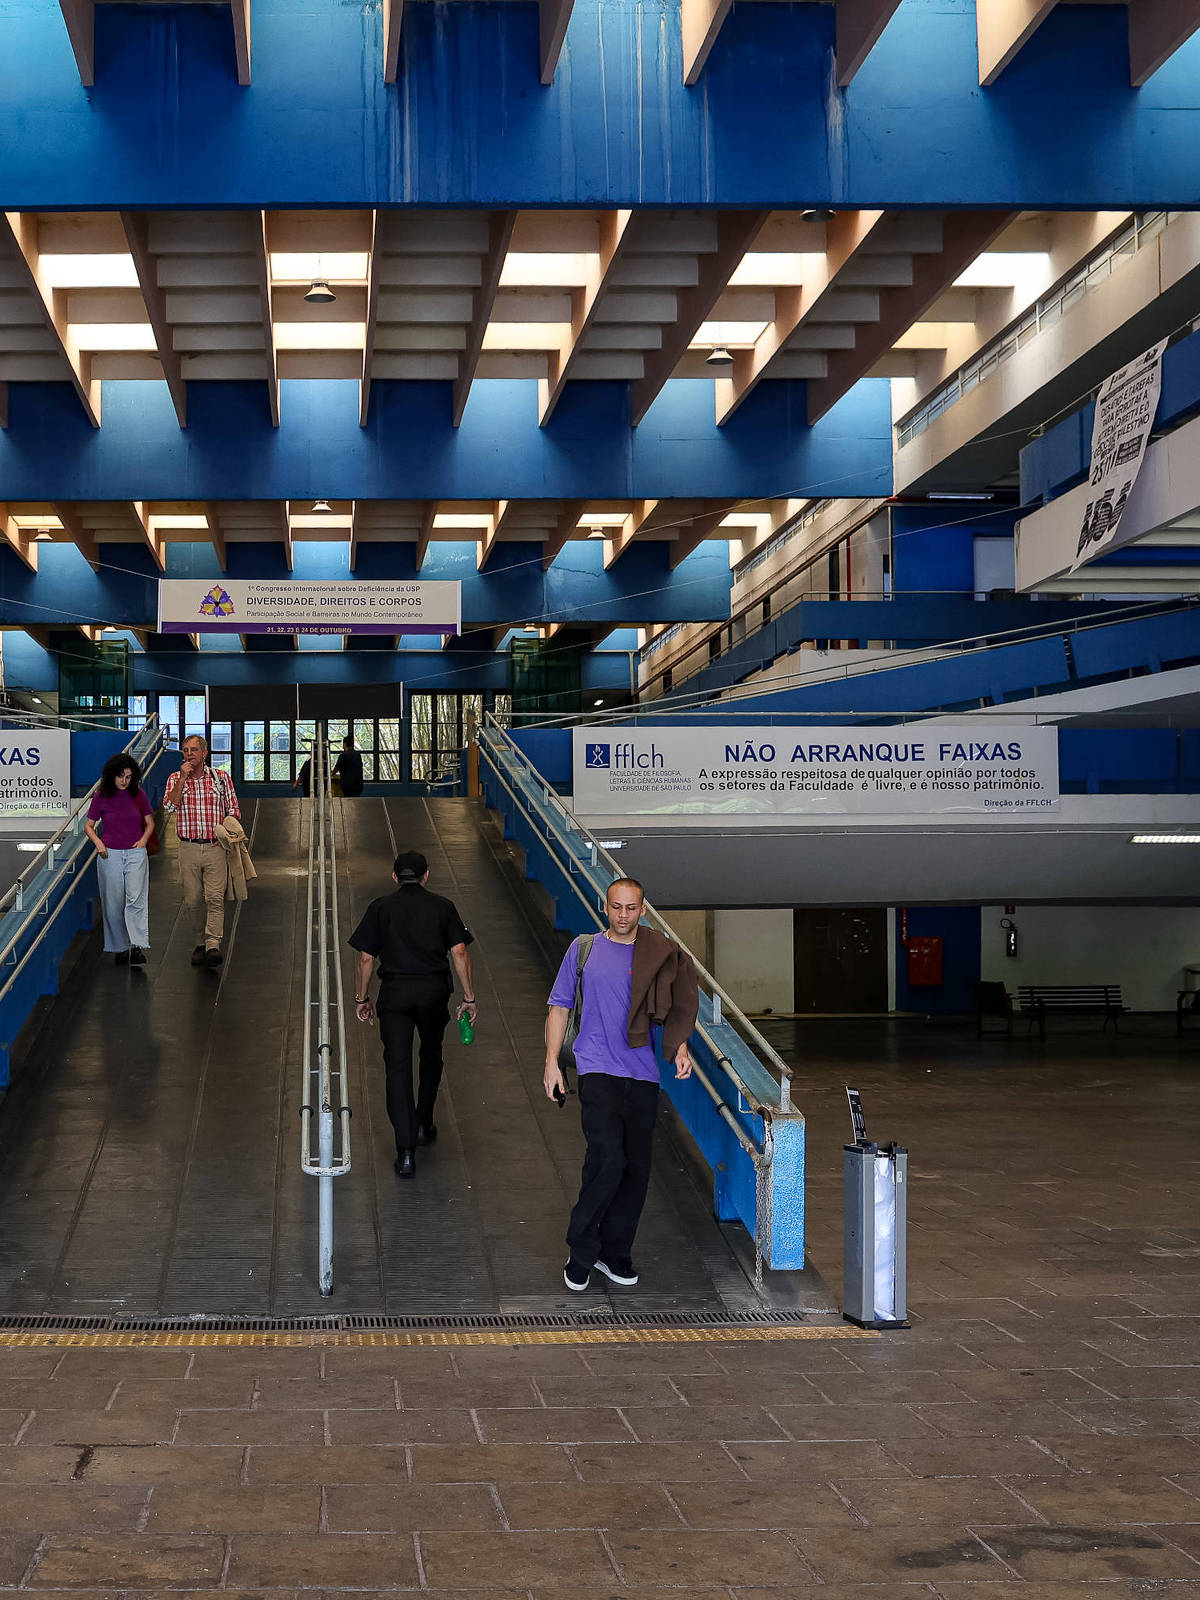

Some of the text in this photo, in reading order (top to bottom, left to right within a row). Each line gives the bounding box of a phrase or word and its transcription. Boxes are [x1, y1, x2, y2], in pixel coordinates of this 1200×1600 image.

[256, 585, 292, 594] Congresso
[246, 597, 422, 607] DIVERSIDADE, DIREITOS E CORPOS
[246, 611, 285, 619] Participação
[373, 611, 423, 619] Contemporâneo
[614, 743, 664, 769] fflch
[725, 739, 1023, 763] NÃO ARRANQUE FAIXAS
[698, 768, 1036, 781] A expressão respeitosa de qualquer opinião por todos
[16, 776, 54, 787] todos
[699, 779, 1045, 792] os setores da Faculdade é livre, e é nosso patrimônio.
[41, 801, 68, 809] FFLCH
[984, 799, 1013, 807] Direção
